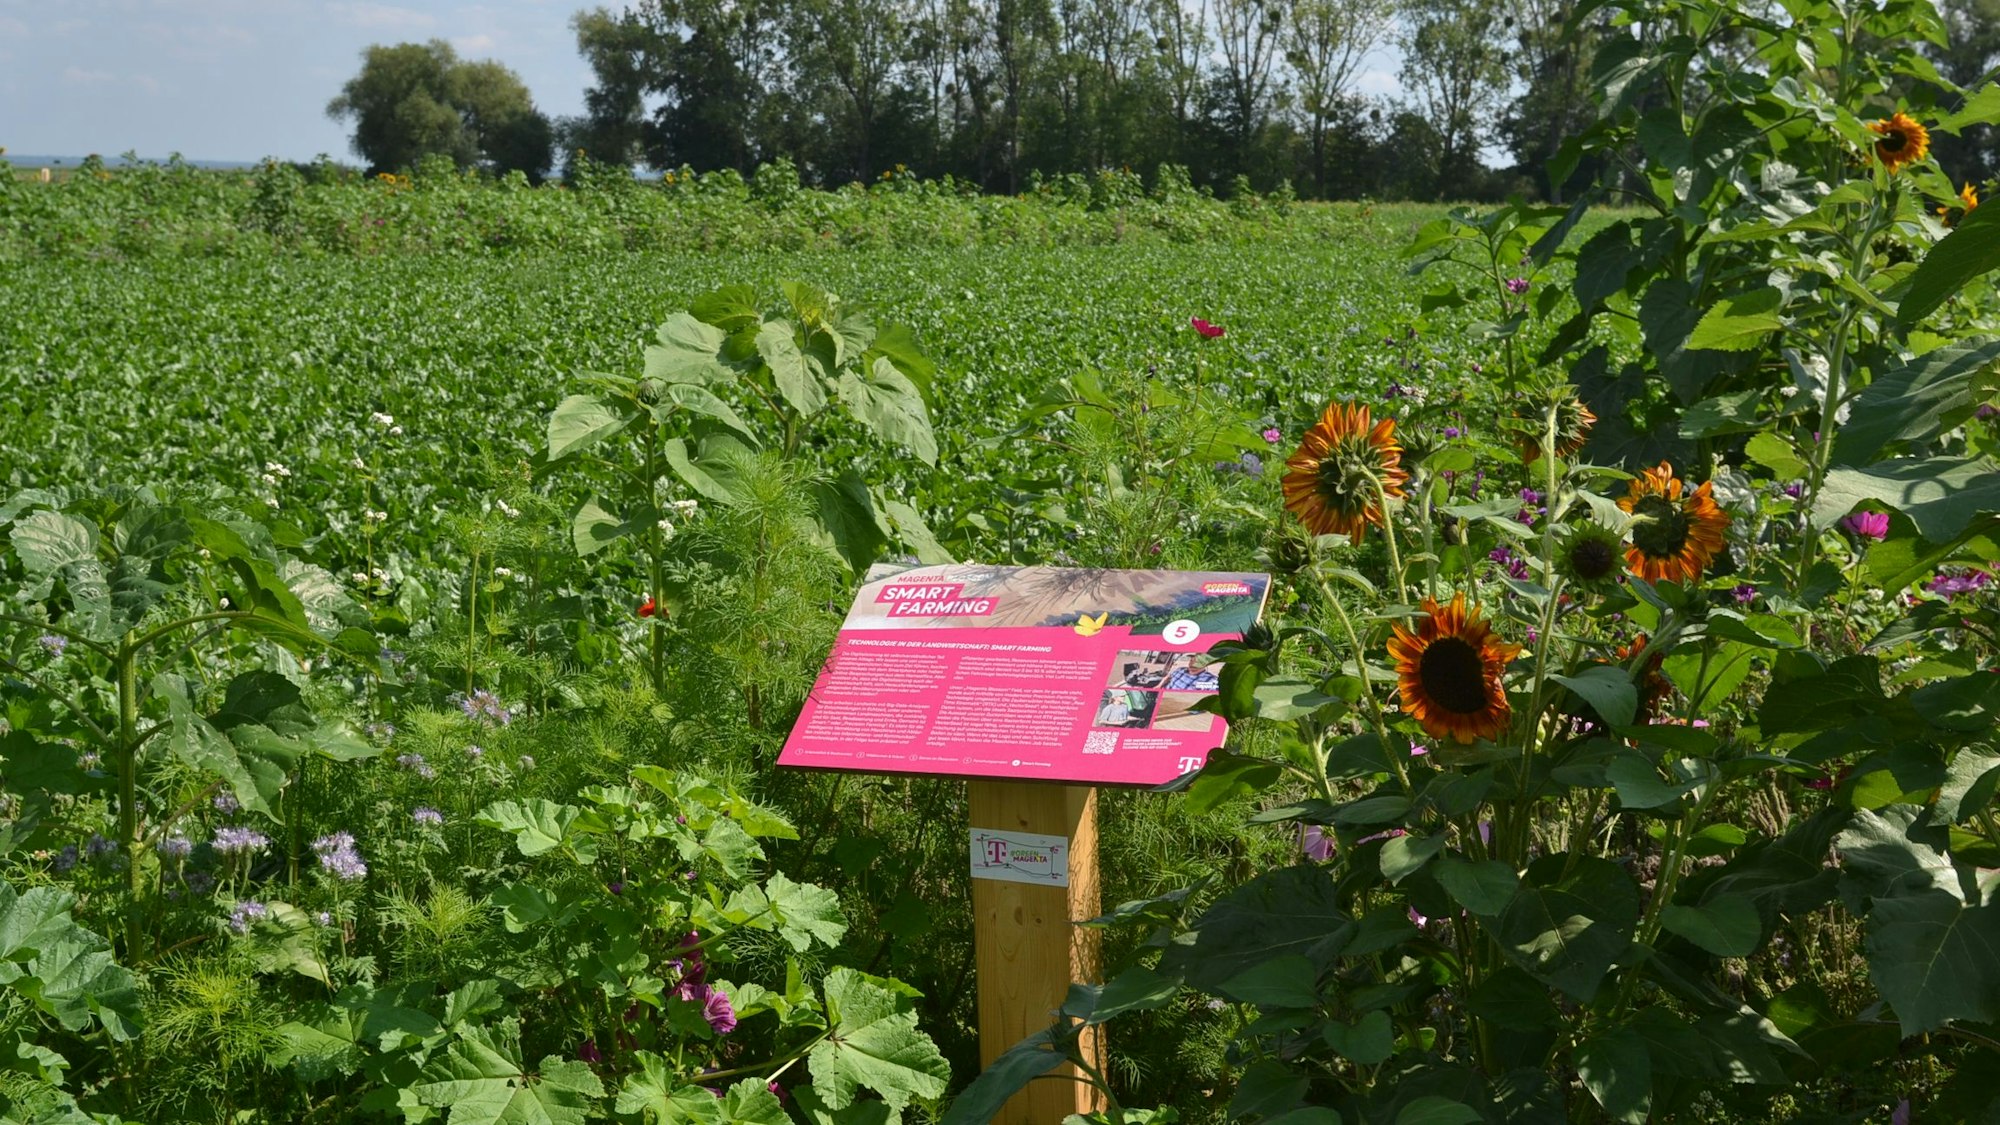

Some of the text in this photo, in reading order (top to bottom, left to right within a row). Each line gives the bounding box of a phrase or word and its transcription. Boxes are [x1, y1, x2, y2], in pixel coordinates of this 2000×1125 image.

[897, 575, 945, 583] MAGENTA
[883, 587, 954, 600] SMART
[1206, 586, 1248, 594] MAGENTA
[895, 602, 989, 614] FARMING
[1174, 626, 1188, 638] 5
[848, 639, 898, 648] TECHNOLOGIE
[921, 641, 990, 651] LANDWIRTSCHAFT:
[1018, 645, 1053, 653] FARMING
